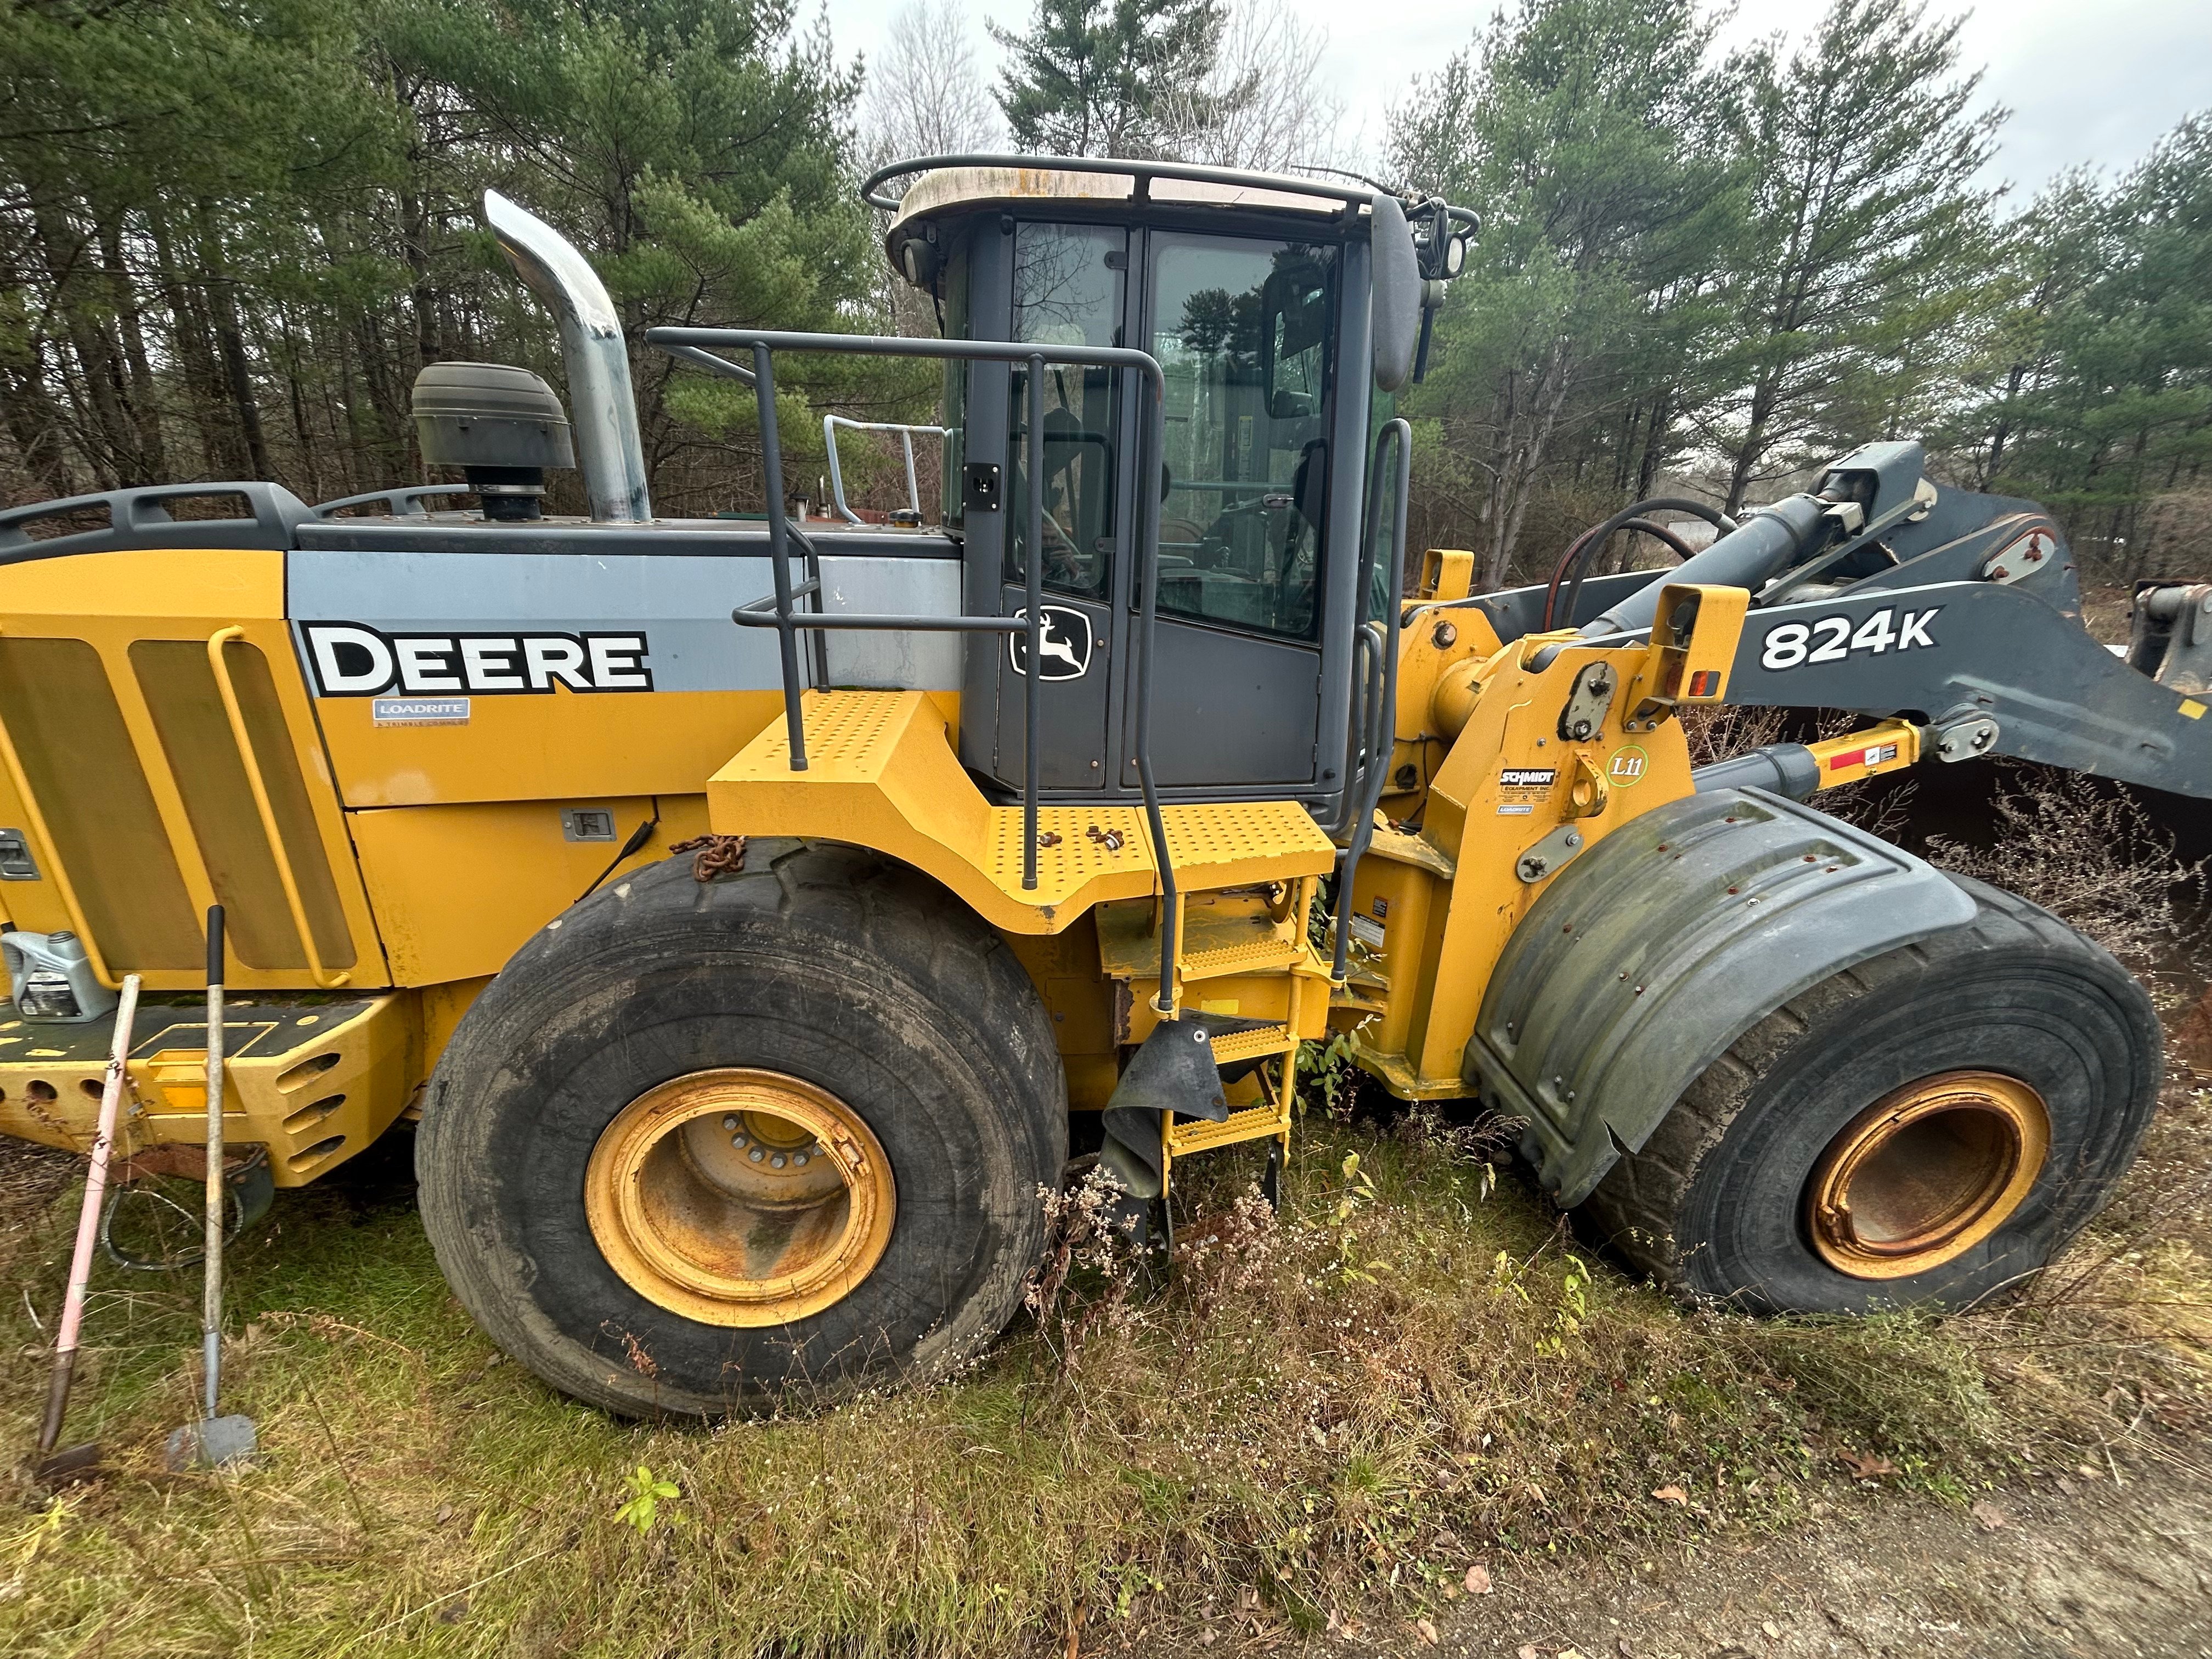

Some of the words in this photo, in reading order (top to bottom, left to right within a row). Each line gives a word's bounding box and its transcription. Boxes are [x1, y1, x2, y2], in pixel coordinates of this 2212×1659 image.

[1762, 608, 1940, 669] 824K
[307, 626, 648, 692] DEERE
[380, 704, 465, 714] LOADRITE
[1610, 757, 1643, 776] L11
[1500, 771, 1554, 786] SCHMIDT
